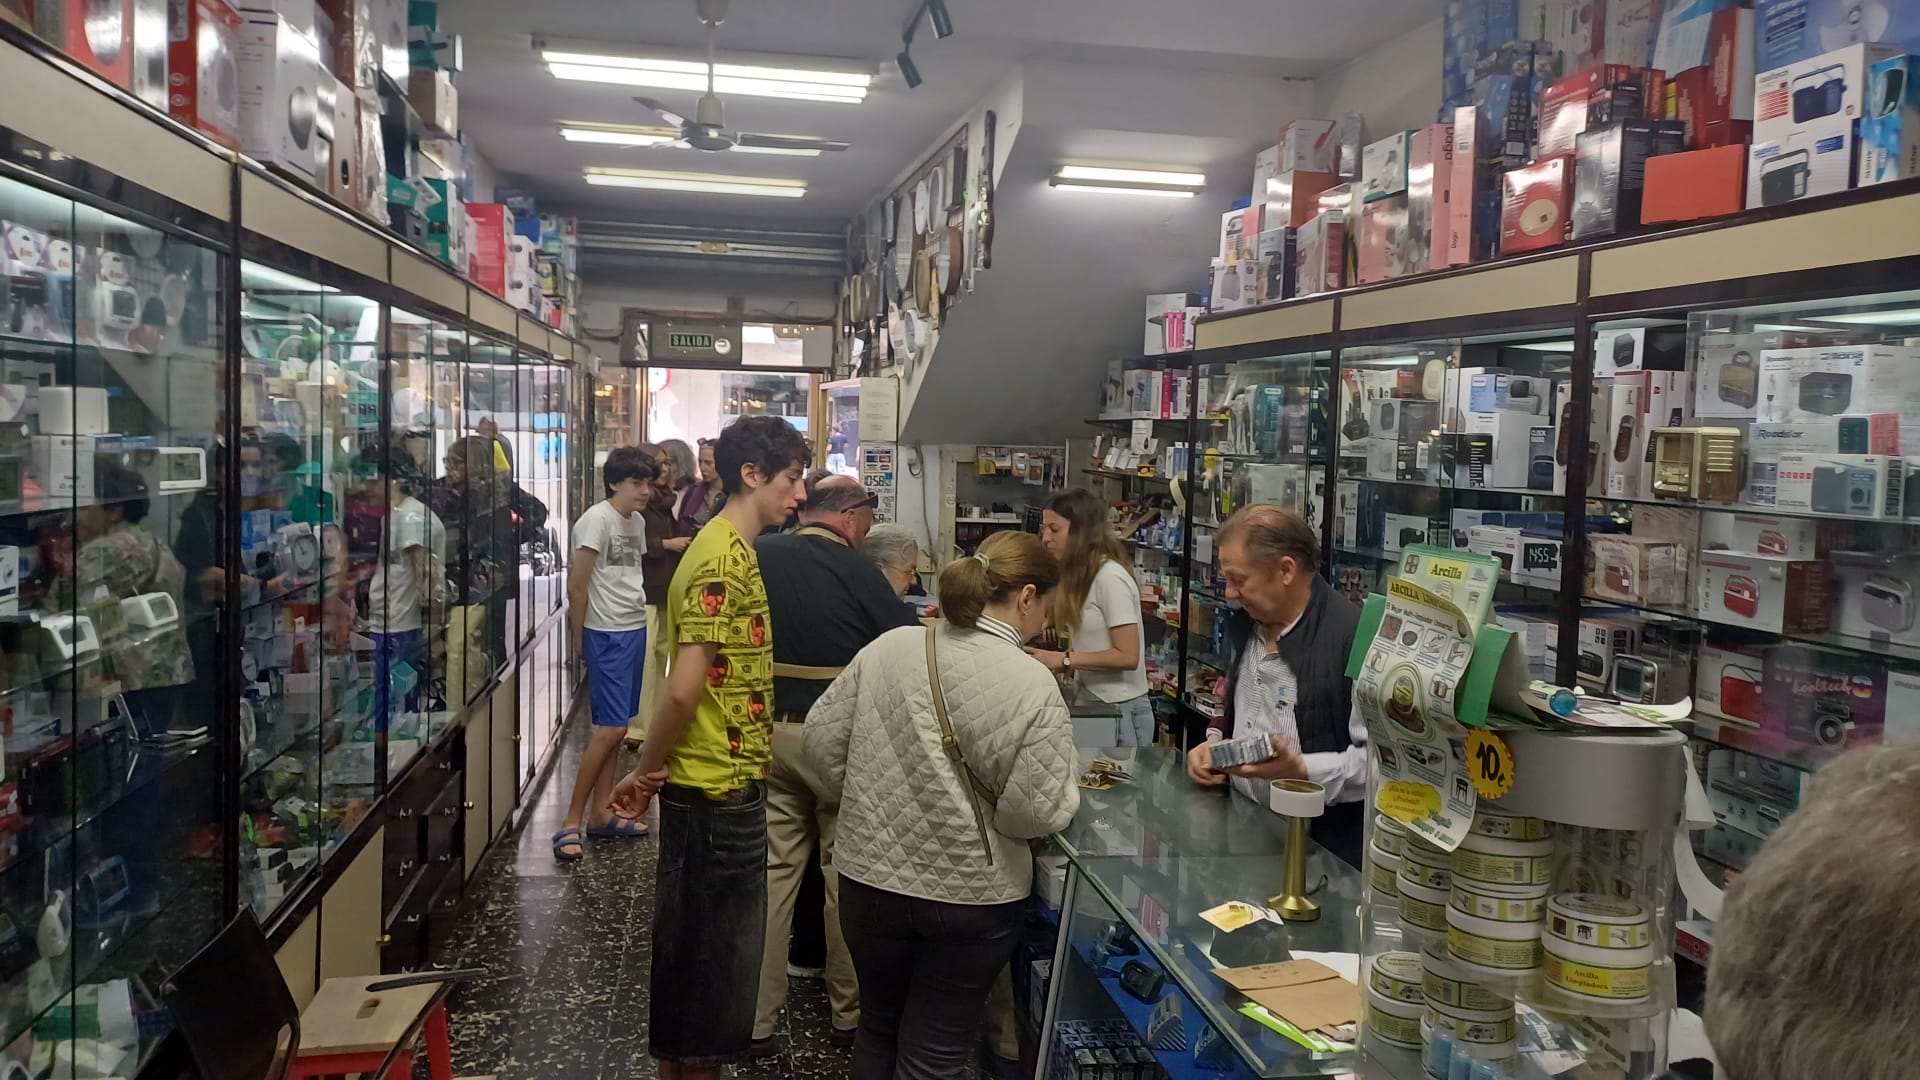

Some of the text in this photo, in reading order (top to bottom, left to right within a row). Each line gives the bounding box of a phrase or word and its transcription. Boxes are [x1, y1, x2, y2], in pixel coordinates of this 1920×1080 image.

[672, 335, 711, 347] SALIDA
[1430, 564, 1463, 580] Arcilla
[1390, 582, 1419, 601] ARCILLA
